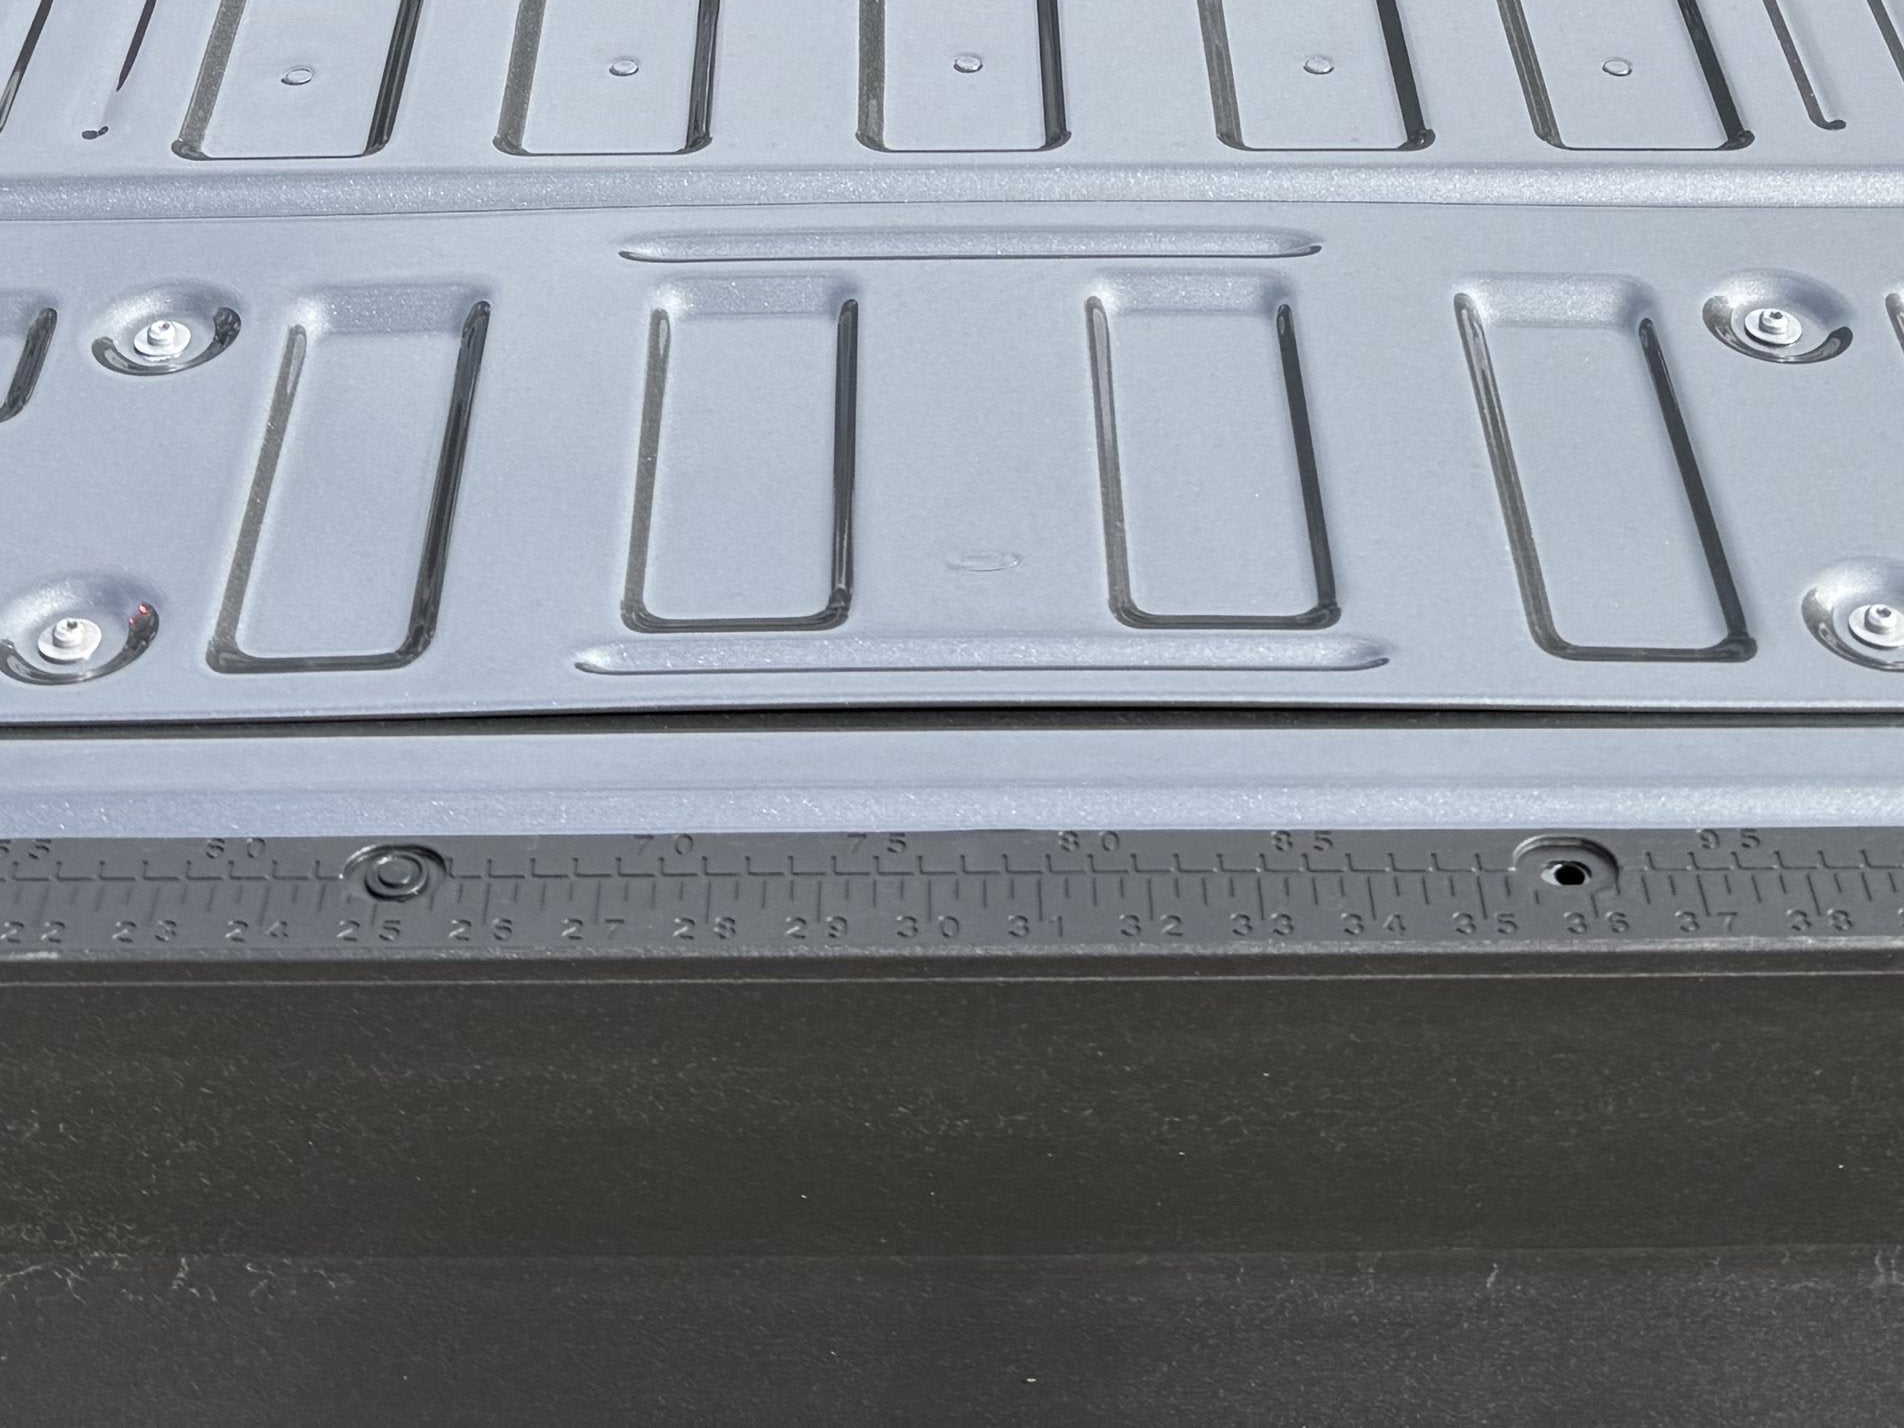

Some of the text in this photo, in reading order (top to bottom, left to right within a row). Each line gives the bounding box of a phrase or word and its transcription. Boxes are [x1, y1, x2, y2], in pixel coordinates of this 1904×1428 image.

[633, 834, 694, 855] 70
[846, 833, 908, 854] 75
[1058, 831, 1120, 852] 80
[1270, 830, 1334, 851] 85
[1697, 829, 1760, 850] 95
[0, 920, 66, 944] 22
[224, 920, 289, 942] 24
[336, 919, 401, 941] 25
[448, 919, 513, 941] 26
[561, 918, 626, 941] 27
[672, 916, 736, 939] 28
[784, 916, 849, 939] 29
[895, 915, 960, 938] 30
[1007, 915, 1064, 938] 31
[1119, 913, 1183, 937] 32
[1230, 913, 1295, 937] 33
[1341, 913, 1406, 937] 34
[1452, 912, 1519, 935] 35
[1563, 911, 1630, 935] 36
[1675, 910, 1738, 933] 37
[1786, 908, 1854, 933] 38
